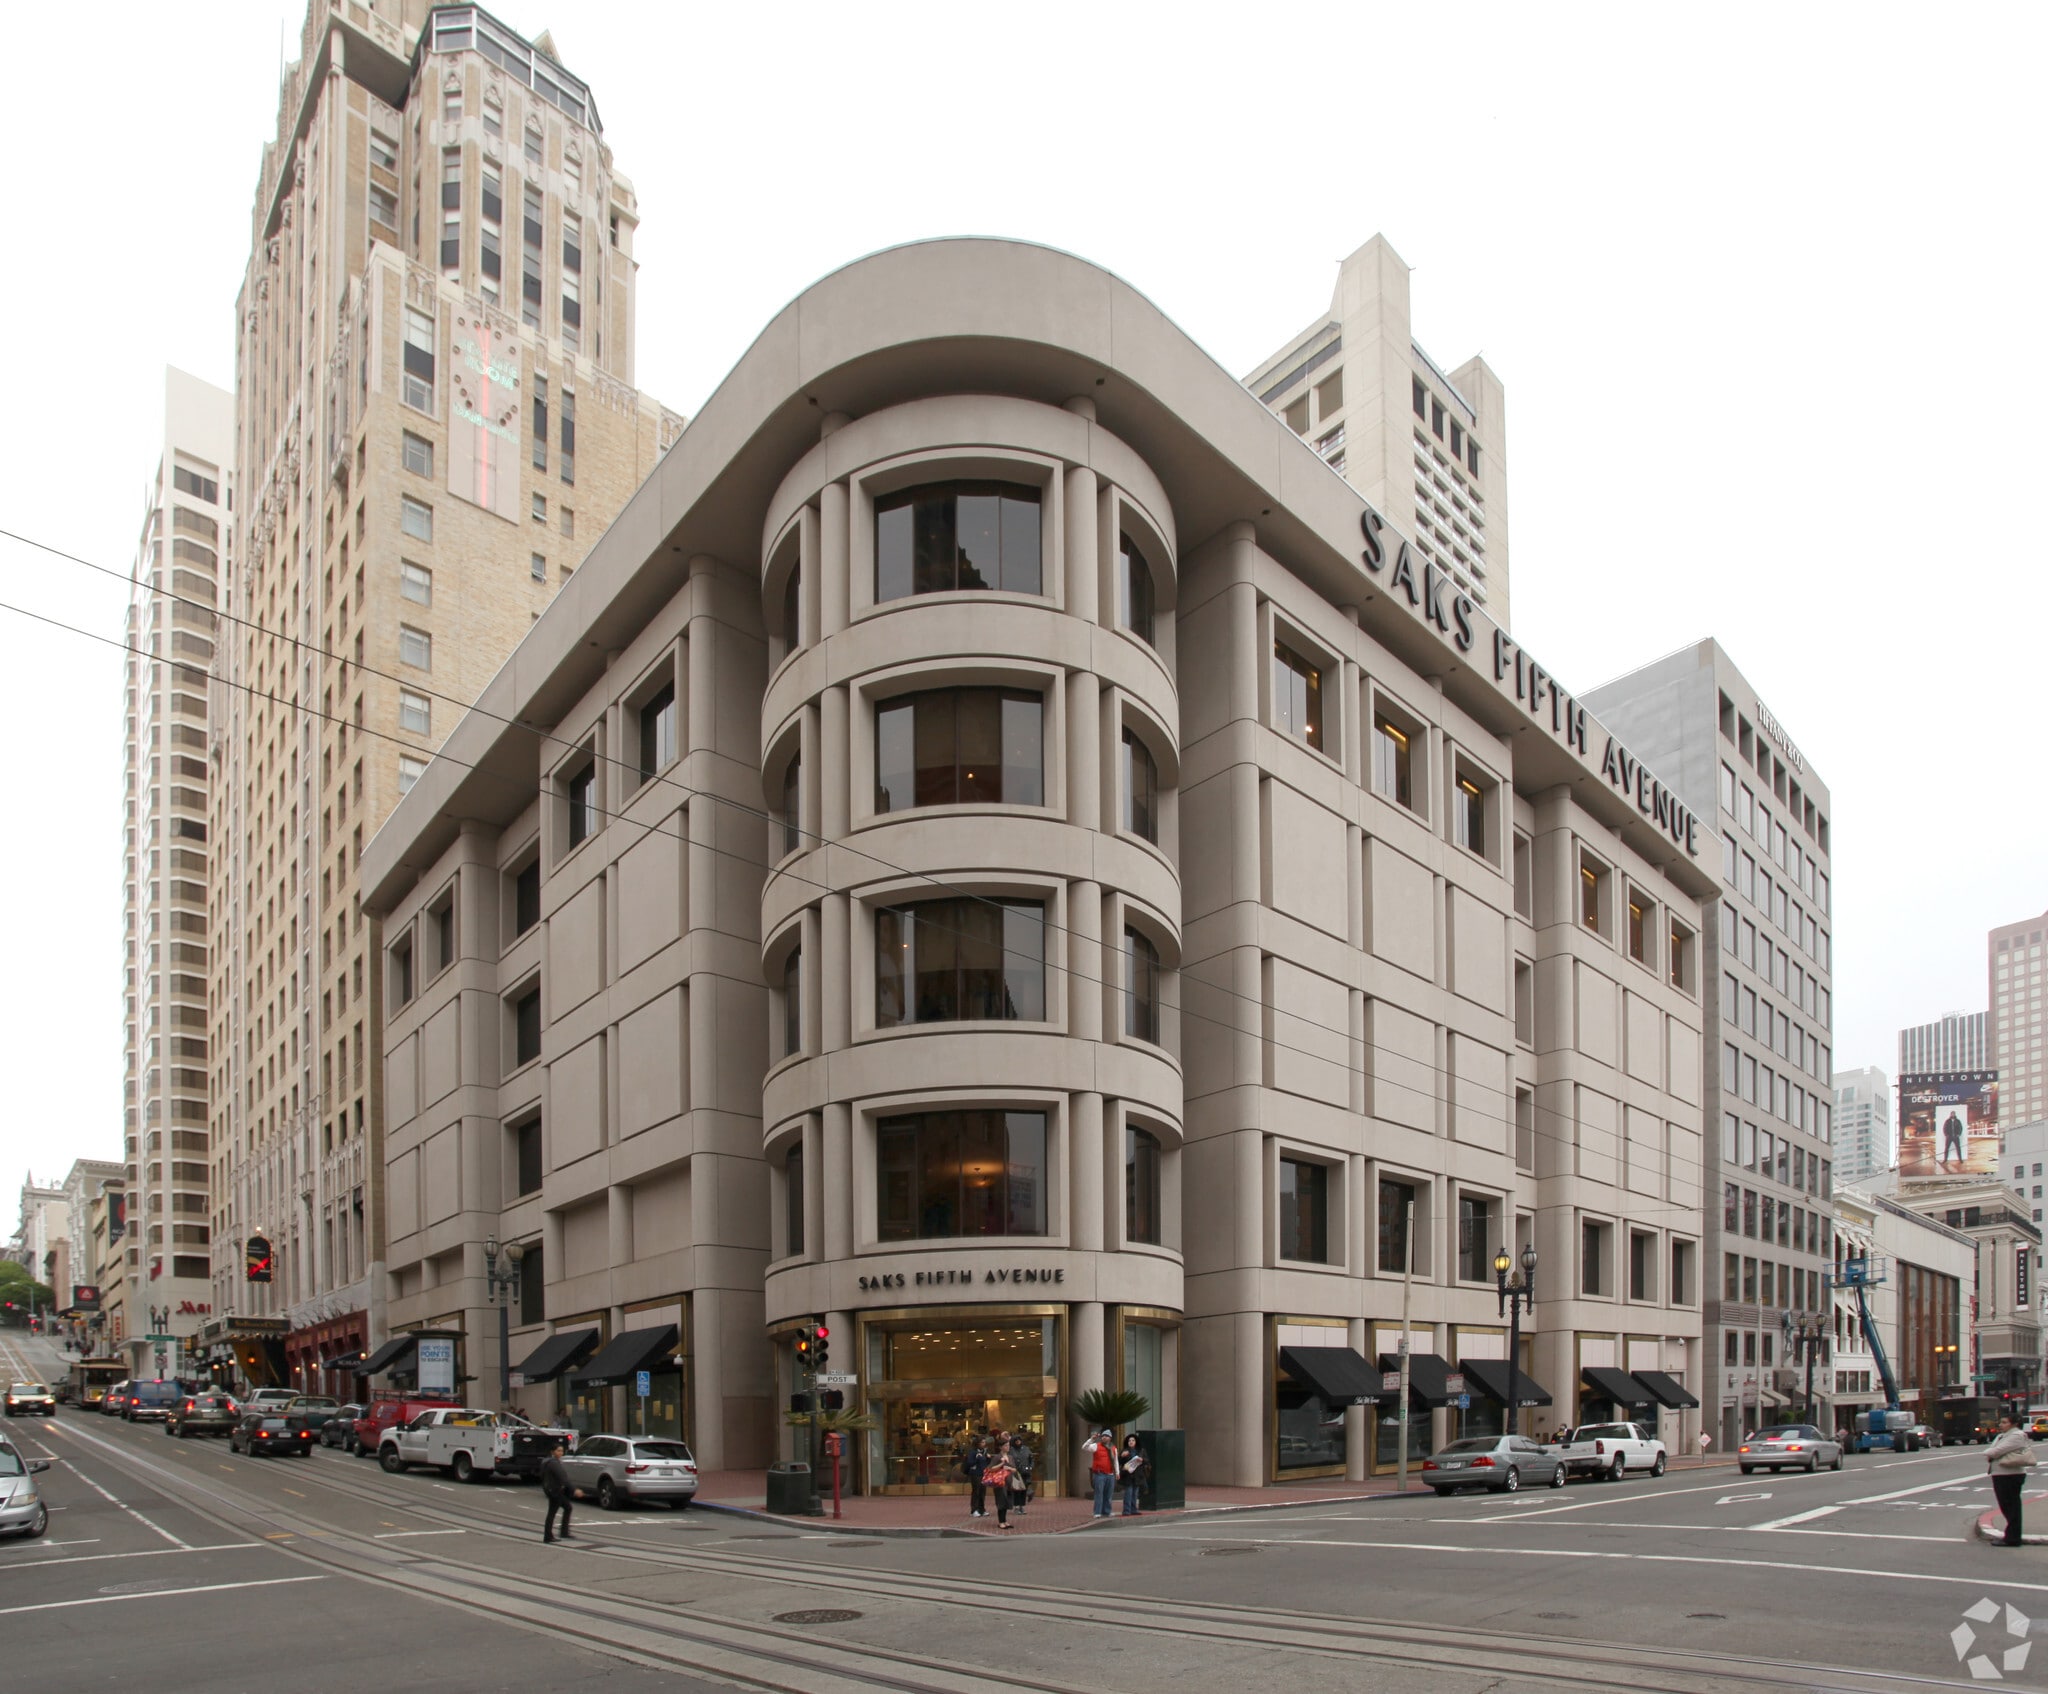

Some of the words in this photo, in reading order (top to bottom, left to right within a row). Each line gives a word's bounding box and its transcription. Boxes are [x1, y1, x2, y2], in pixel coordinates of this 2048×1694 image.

[1361, 508, 1474, 651] SAKS
[1494, 628, 1588, 754] FIFTH
[1602, 736, 1699, 857] AVENUE
[1756, 701, 1788, 751] TIFFANY
[1906, 1073, 1993, 1084] NIKETOWN
[1911, 1094, 1959, 1103] DESTROYER
[858, 1274, 905, 1290] SAKS
[916, 1270, 972, 1286] FIFTH
[985, 1268, 1066, 1284] AVENUE
